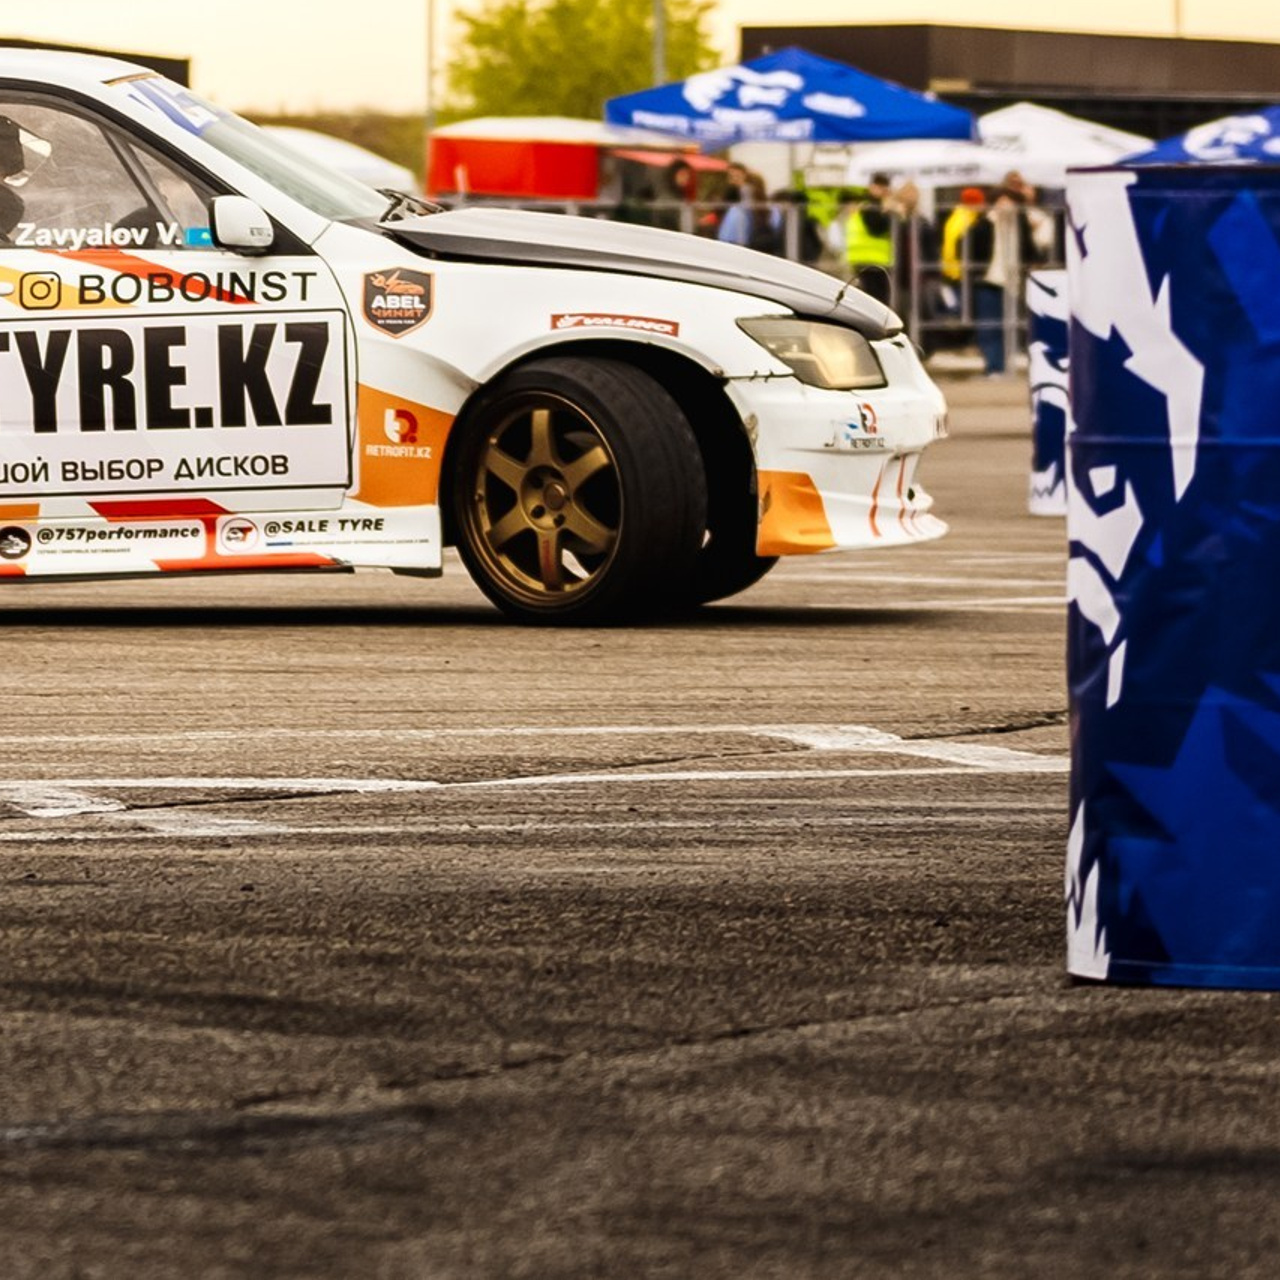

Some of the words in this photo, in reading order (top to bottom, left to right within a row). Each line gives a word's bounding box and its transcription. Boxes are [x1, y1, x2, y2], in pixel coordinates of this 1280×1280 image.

[15, 223, 149, 252] Zavyalov
[157, 223, 182, 245] V.
[78, 271, 317, 305] BOBOINST
[371, 295, 426, 309] ABEL
[62, 459, 164, 482] ВЫБОР
[174, 455, 289, 480] ДИСКОВ
[36, 525, 200, 545] @757performance
[264, 519, 329, 538] @SALE
[338, 518, 385, 531] TYRE
